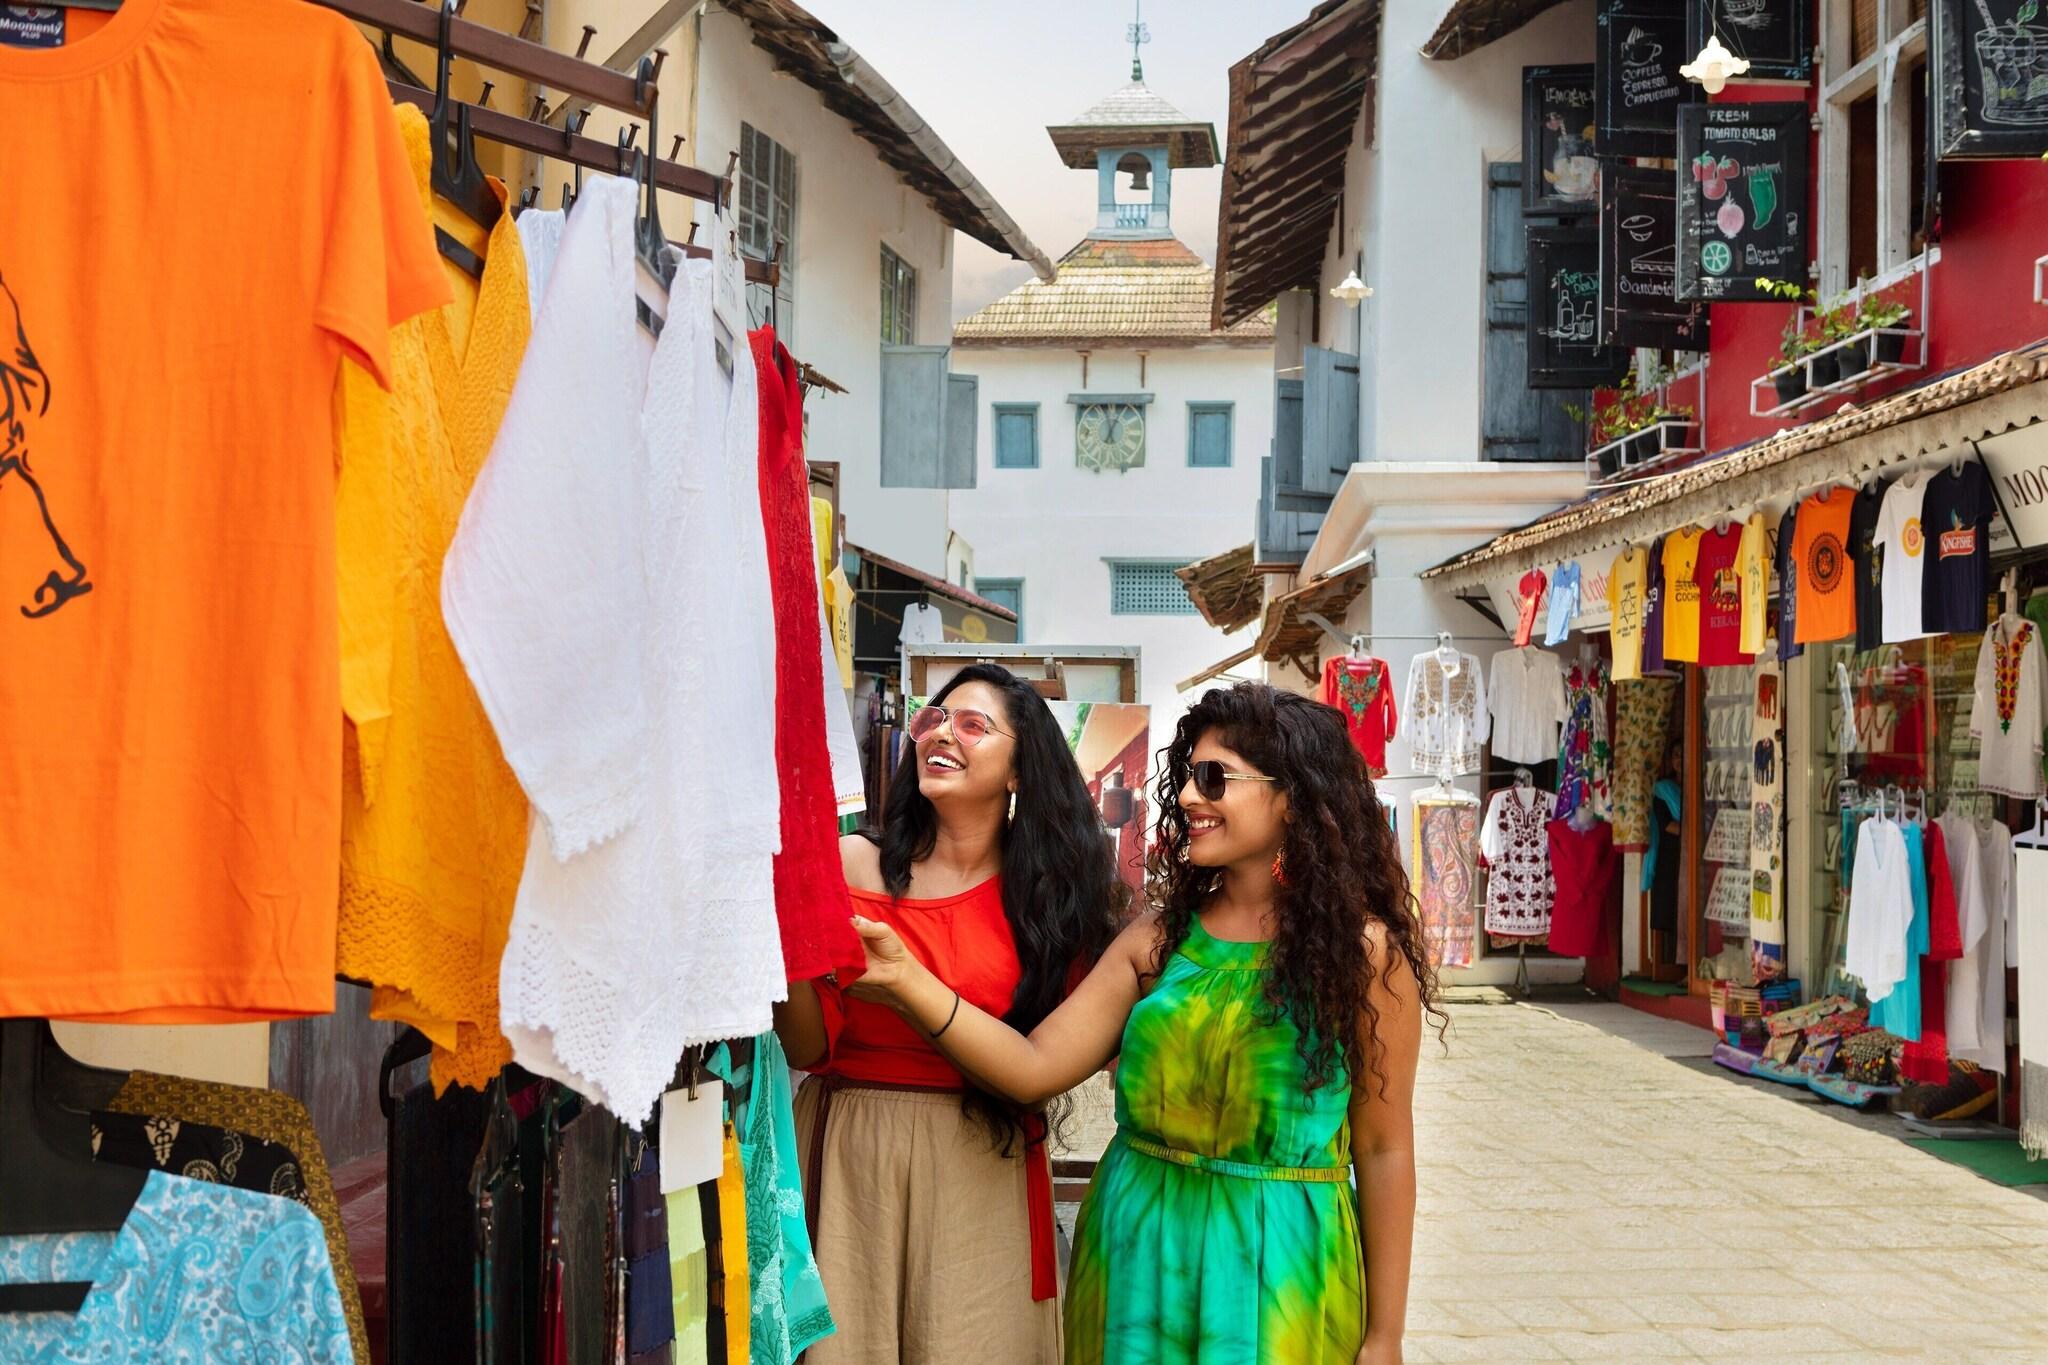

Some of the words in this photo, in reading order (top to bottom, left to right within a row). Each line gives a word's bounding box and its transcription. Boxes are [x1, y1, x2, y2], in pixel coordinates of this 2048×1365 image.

[1709, 110, 1750, 123] FRESH
[1704, 127, 1741, 141] TOMATO
[1742, 127, 1776, 141] SALSA
[1710, 615, 1739, 628] KERAL
